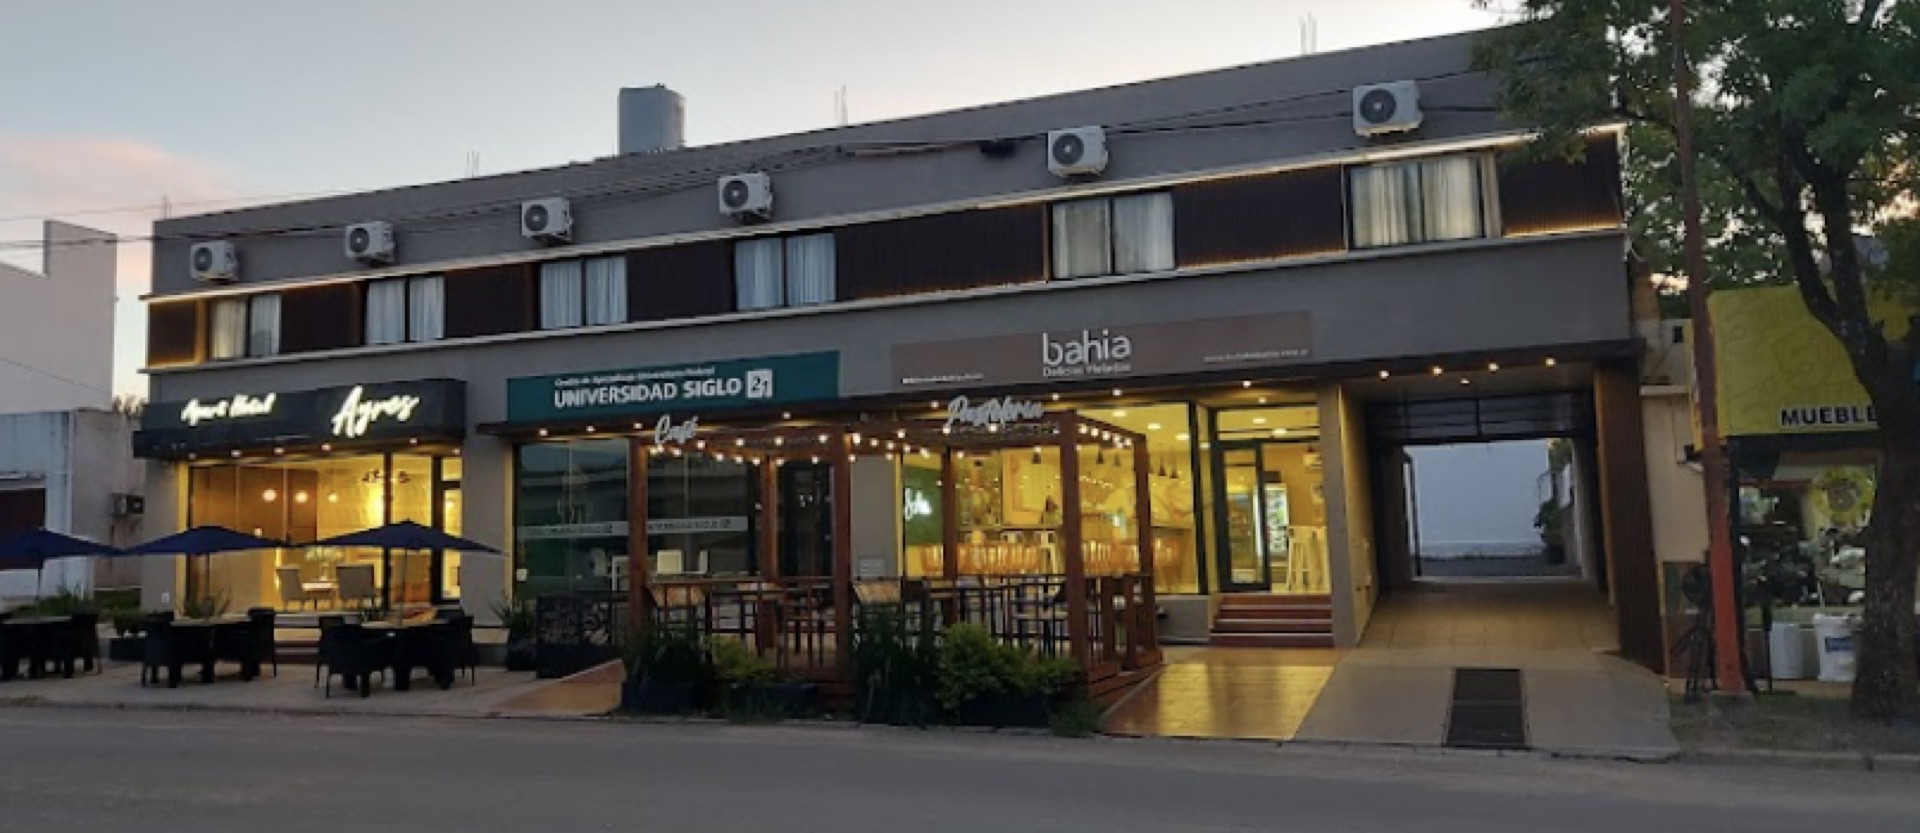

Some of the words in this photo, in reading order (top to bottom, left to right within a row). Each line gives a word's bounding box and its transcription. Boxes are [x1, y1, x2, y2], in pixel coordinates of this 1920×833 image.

[1043, 329, 1132, 365] bahia
[555, 382, 677, 409] UNIVERSIDAD
[683, 377, 742, 399] SIGLO
[748, 370, 773, 398] 21
